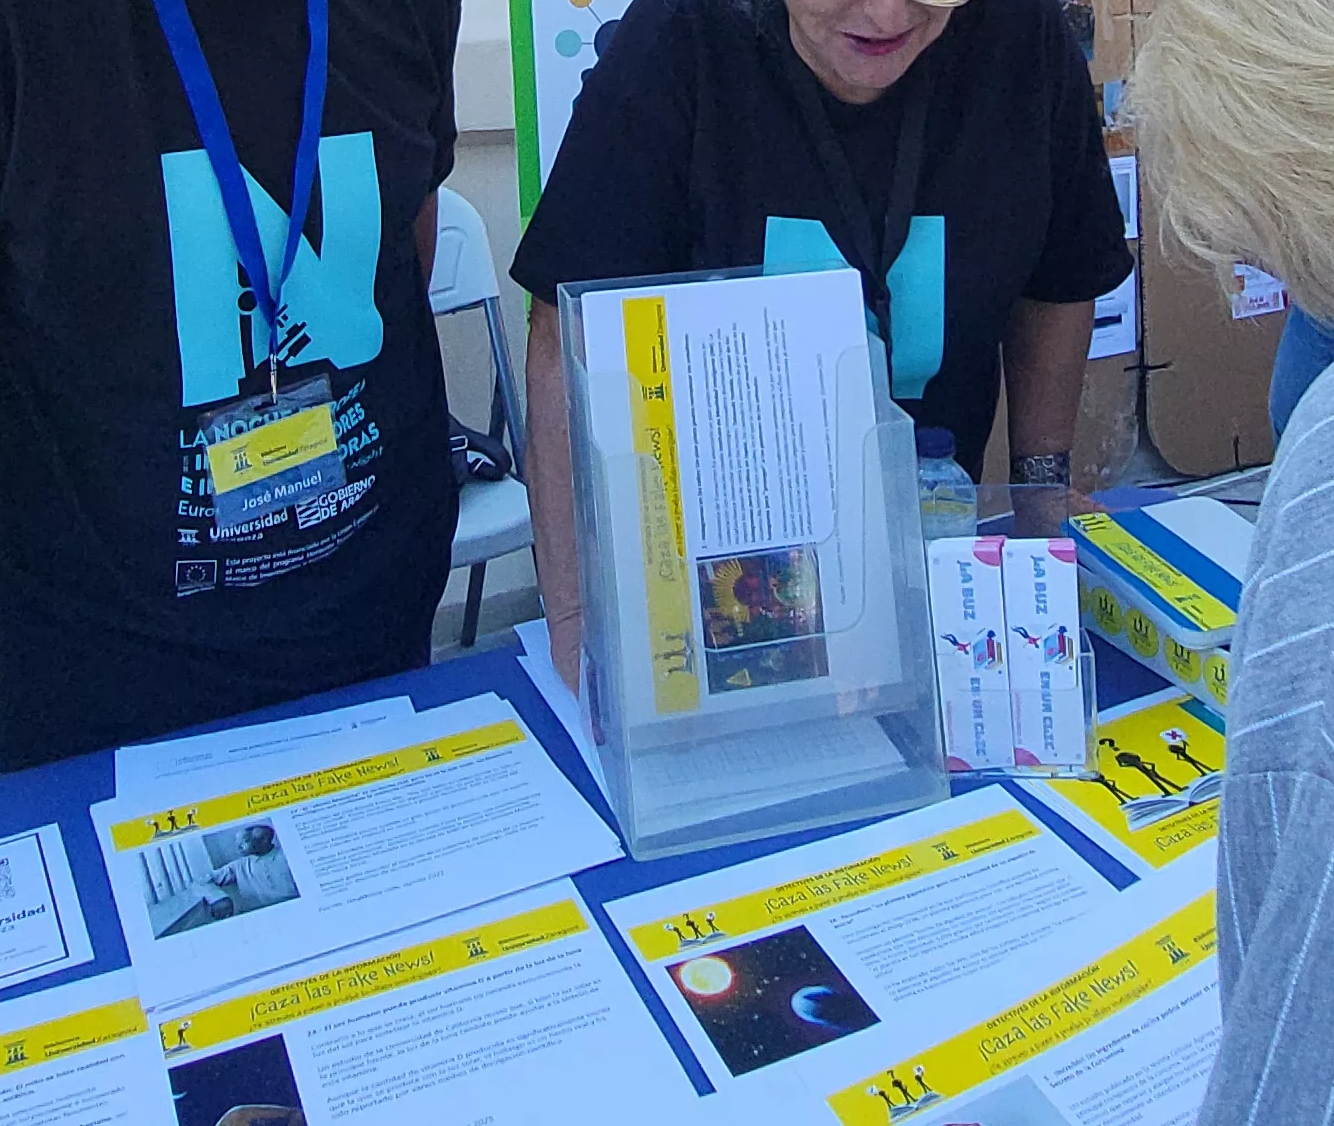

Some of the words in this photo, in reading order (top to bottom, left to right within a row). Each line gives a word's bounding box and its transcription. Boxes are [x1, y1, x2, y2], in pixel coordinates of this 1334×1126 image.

[178, 428, 209, 449] LA
[242, 494, 272, 512] José
[274, 470, 322, 496] Manuel
[318, 474, 376, 506] GOBIERNO
[209, 509, 288, 540] Universidad
[317, 766, 353, 790] Fake
[809, 884, 833, 897] las
[833, 871, 869, 892] Fake
[303, 985, 332, 1002] las
[336, 970, 379, 993] Fake
[383, 949, 435, 978] News!
[1020, 1011, 1052, 1034] las
[1049, 991, 1092, 1021] Fake
[1088, 959, 1140, 998] News!
